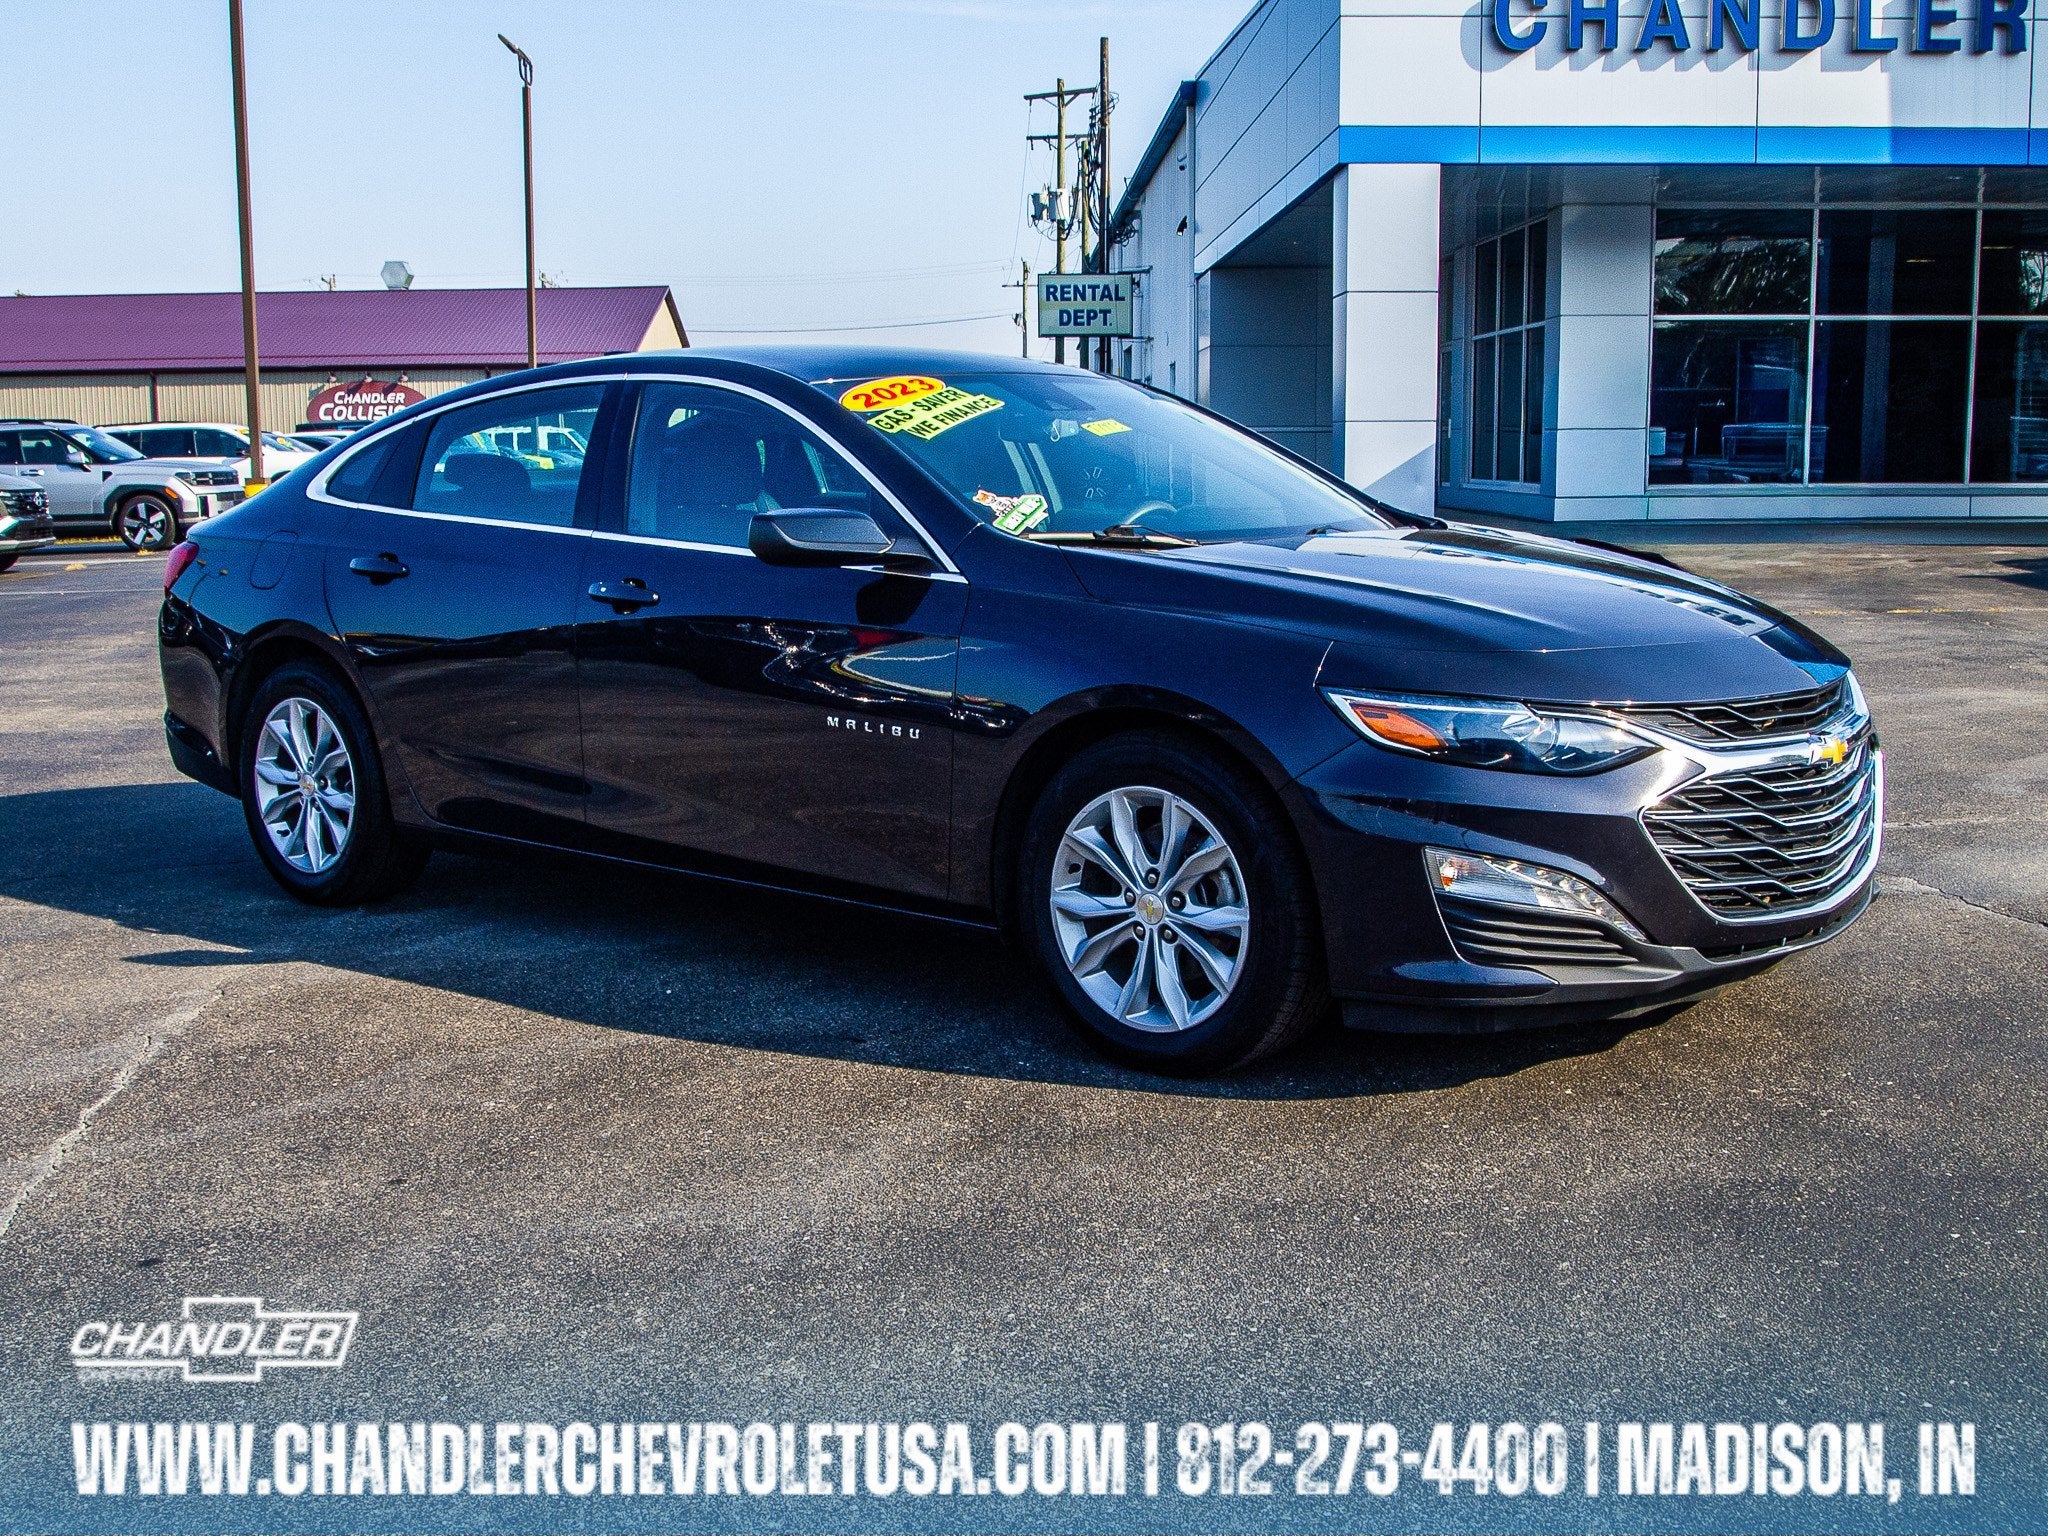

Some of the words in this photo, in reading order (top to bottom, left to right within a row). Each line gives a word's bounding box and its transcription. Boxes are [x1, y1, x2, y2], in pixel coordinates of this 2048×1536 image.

[1494, 0, 2028, 53] CHANDLER
[1045, 284, 1125, 301] RENTAL
[1058, 309, 1113, 326] DEPT.
[334, 391, 406, 404] CHANDLER
[852, 379, 935, 408] 2023
[907, 420, 940, 437] WE
[932, 397, 998, 426] FINANCE
[826, 715, 920, 739] MALIBU
